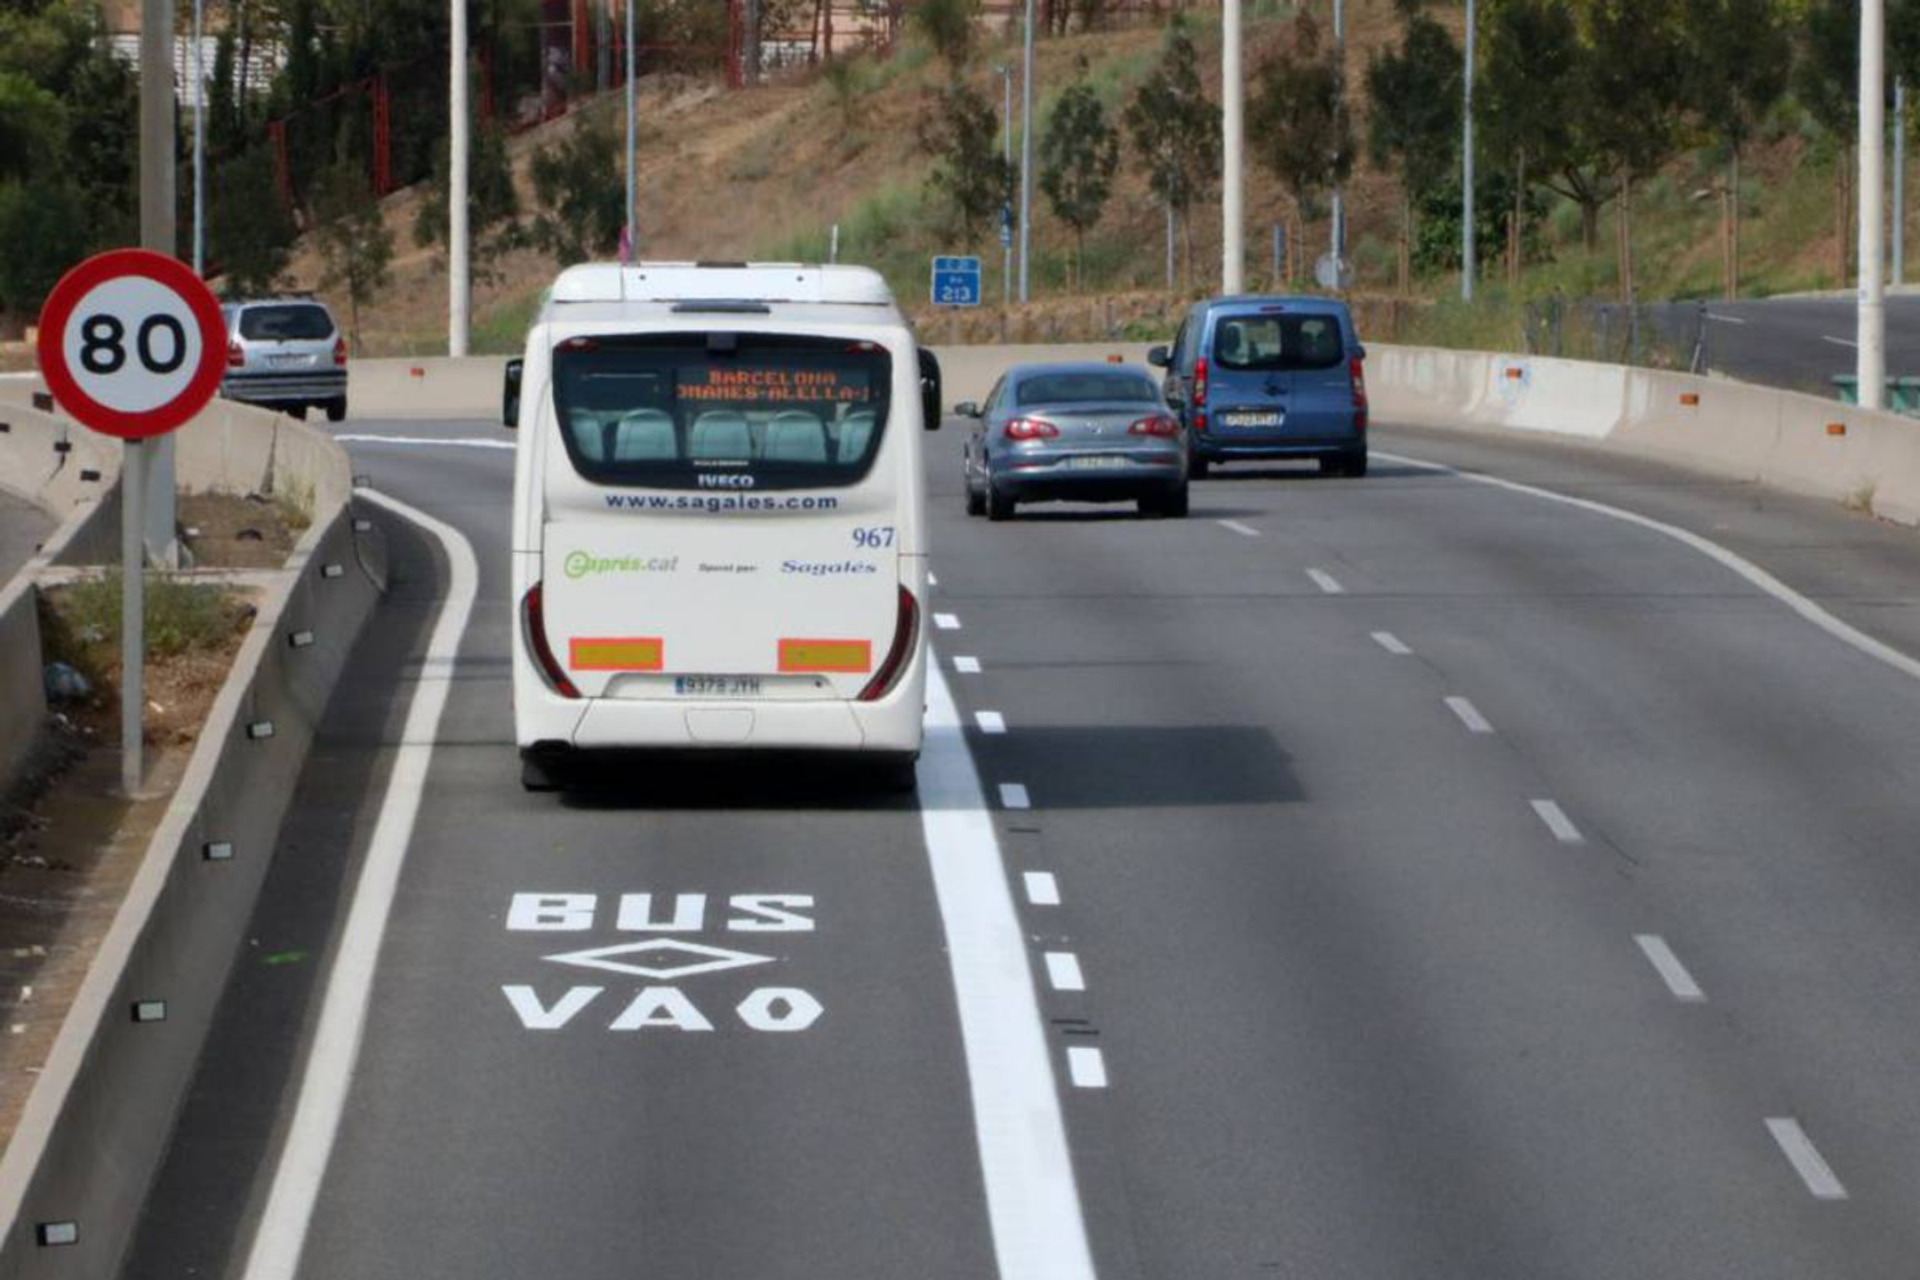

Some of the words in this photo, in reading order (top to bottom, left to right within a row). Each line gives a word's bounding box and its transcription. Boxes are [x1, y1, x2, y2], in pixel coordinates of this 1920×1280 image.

[80, 314, 187, 365] 80
[708, 370, 837, 385] BARCELONA
[698, 474, 755, 489] IVECO
[606, 491, 839, 512] www.sagales.com
[852, 527, 895, 548] 967
[506, 892, 815, 931] BUS
[501, 985, 825, 1033] VAO
